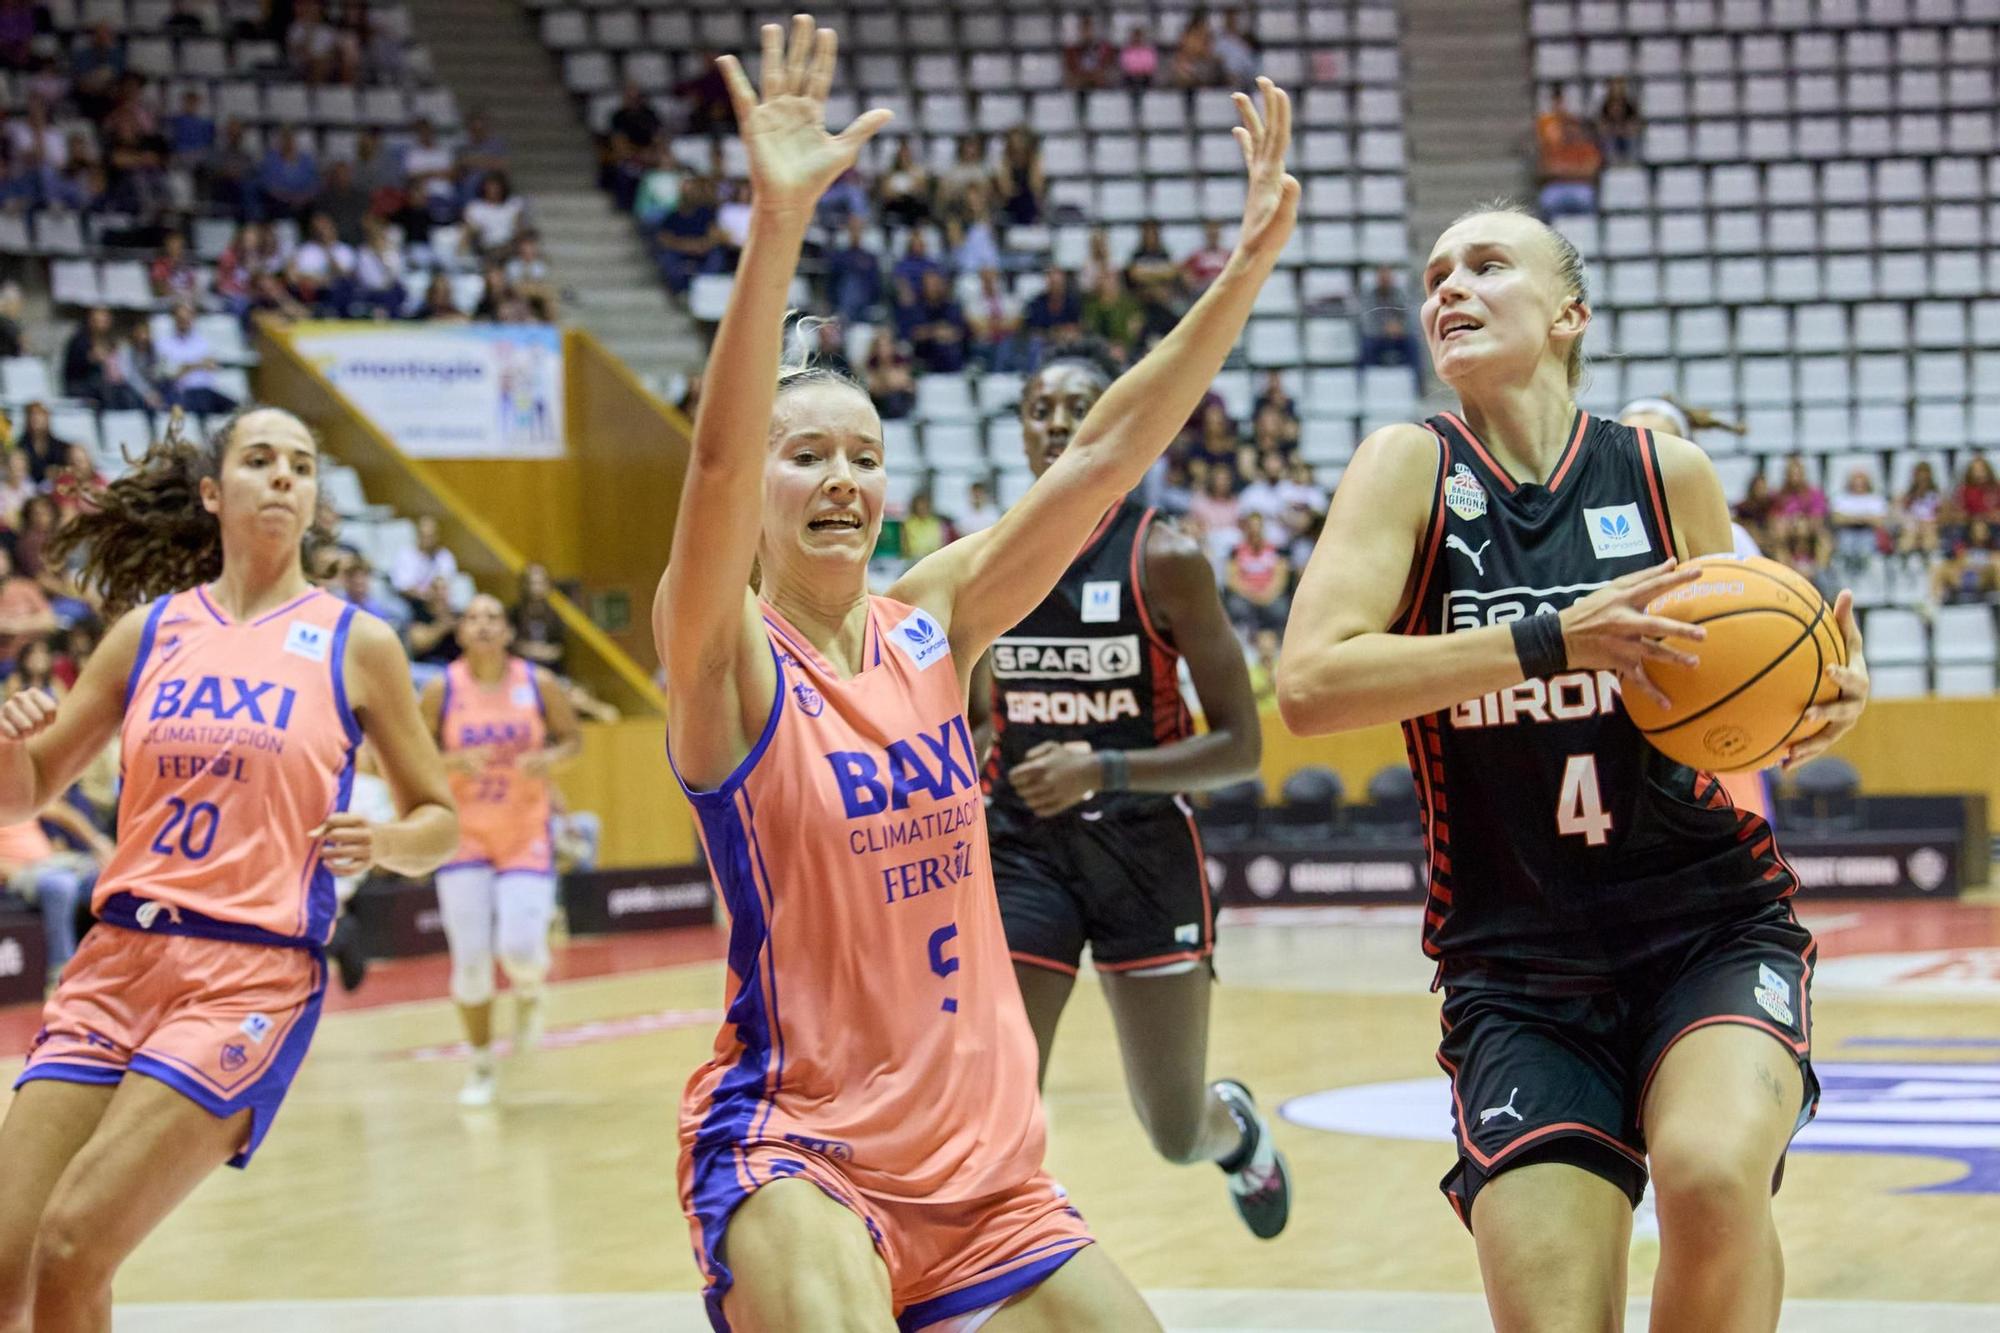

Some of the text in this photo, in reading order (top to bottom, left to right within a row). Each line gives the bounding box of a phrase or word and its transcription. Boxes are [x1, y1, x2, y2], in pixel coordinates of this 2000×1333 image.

[1448, 494, 1486, 512] GIRONA
[1452, 598, 1587, 634] SP
[994, 646, 1090, 672] SPAR
[149, 676, 297, 731] BAXI
[1449, 669, 1623, 730] GIRON
[825, 714, 978, 819] BAXI
[150, 796, 221, 861] 20
[1556, 753, 1614, 846] 4
